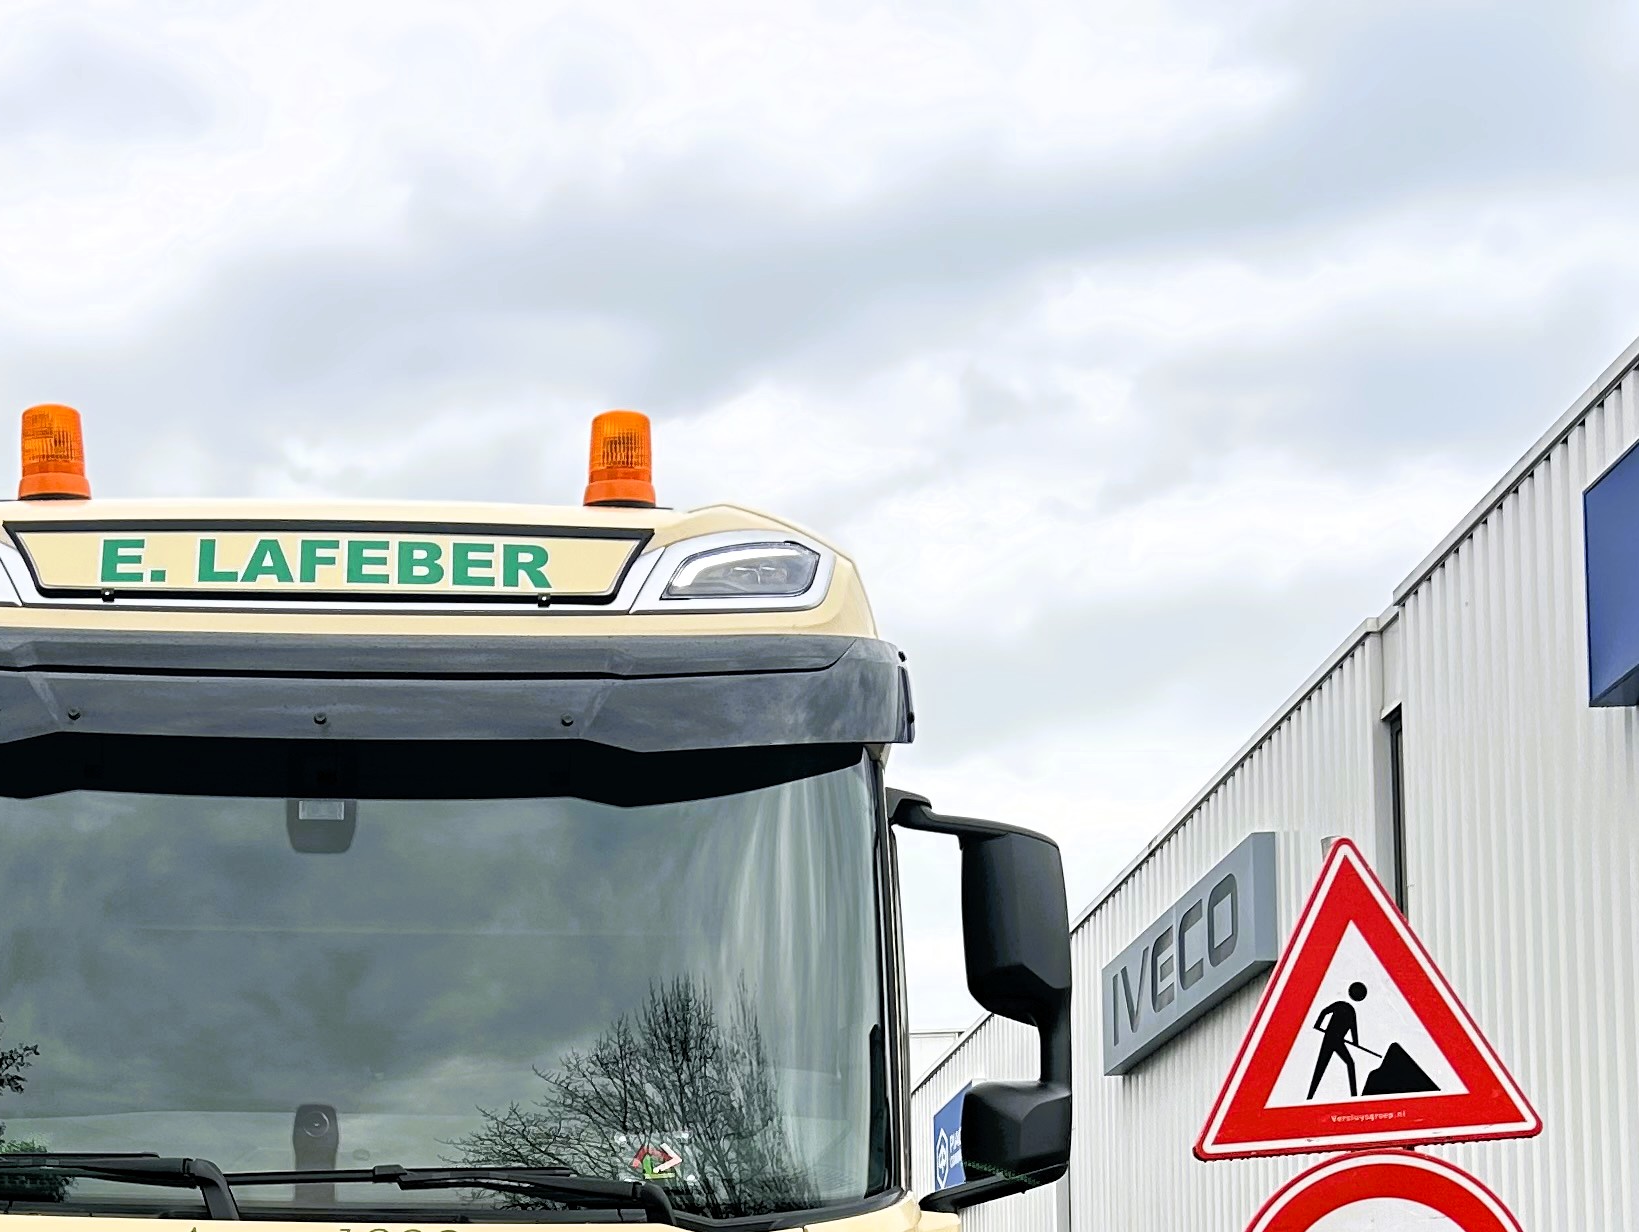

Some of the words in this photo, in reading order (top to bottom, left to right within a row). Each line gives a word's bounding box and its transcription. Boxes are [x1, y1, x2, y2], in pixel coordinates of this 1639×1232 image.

[100, 538, 168, 584] E.
[196, 538, 551, 588] LAFEBER
[1110, 872, 1240, 1046] IVECO
